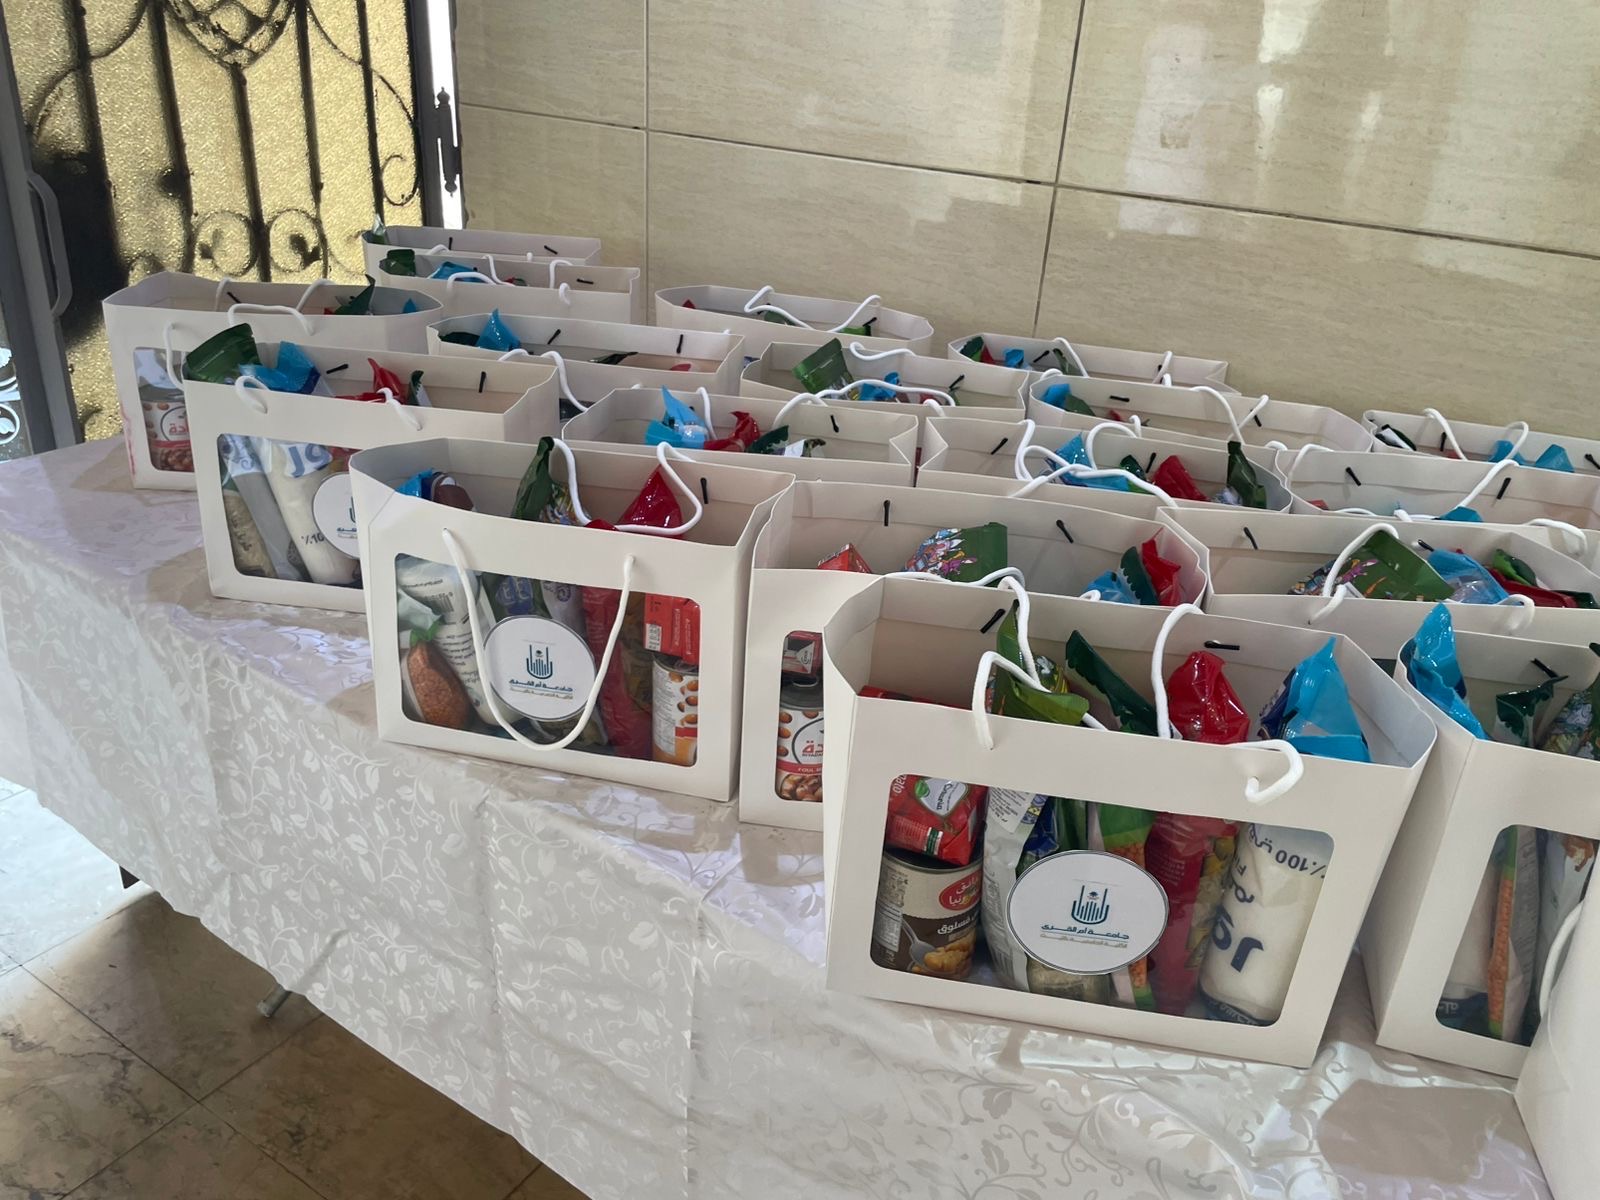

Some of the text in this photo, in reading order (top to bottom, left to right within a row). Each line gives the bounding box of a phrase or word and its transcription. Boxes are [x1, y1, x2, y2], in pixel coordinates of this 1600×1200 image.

[1041, 924, 1130, 940] جامعة أم القرى
